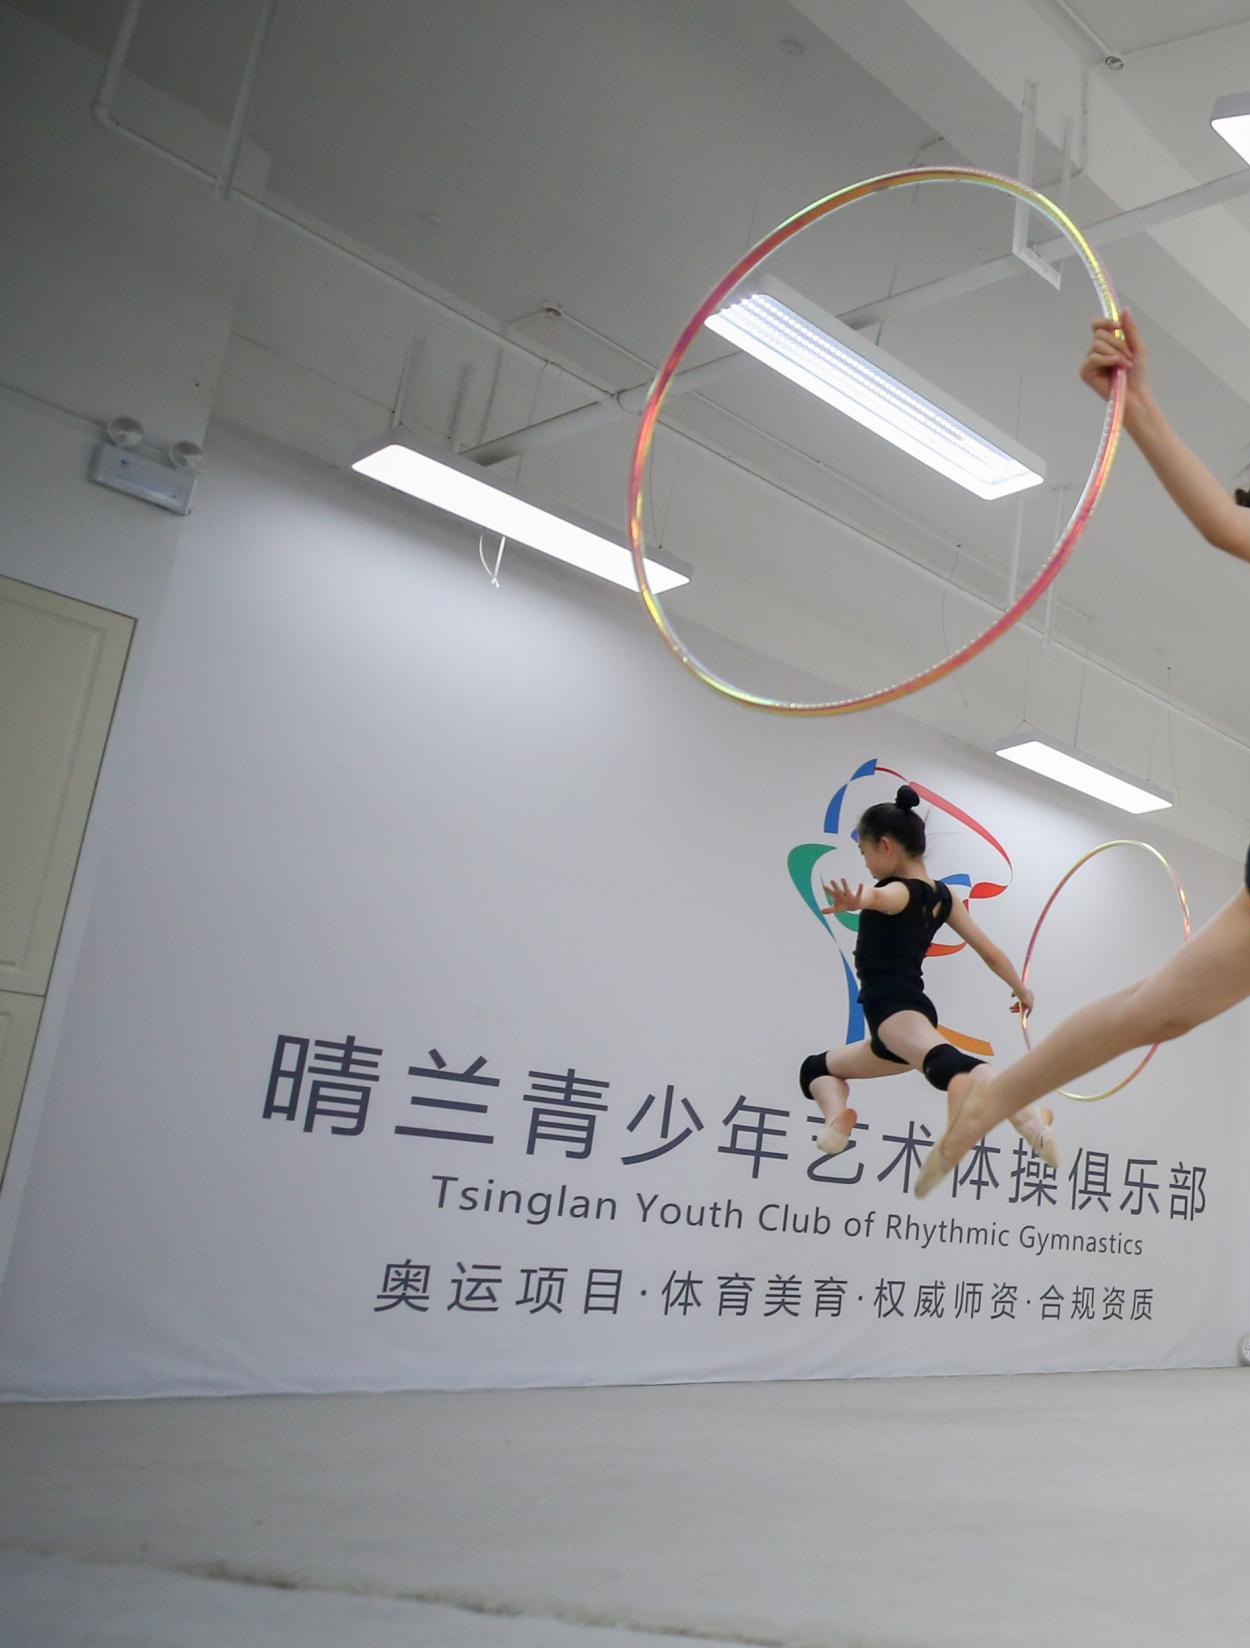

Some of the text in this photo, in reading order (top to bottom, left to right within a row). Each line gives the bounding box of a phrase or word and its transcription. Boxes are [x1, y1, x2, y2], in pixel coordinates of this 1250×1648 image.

[262, 1034, 1207, 1222] 晴兰青少年艺术体操俱乐部
[431, 1174, 1143, 1257] Tsinglan Youth Club of Rhythmic Gymnastics
